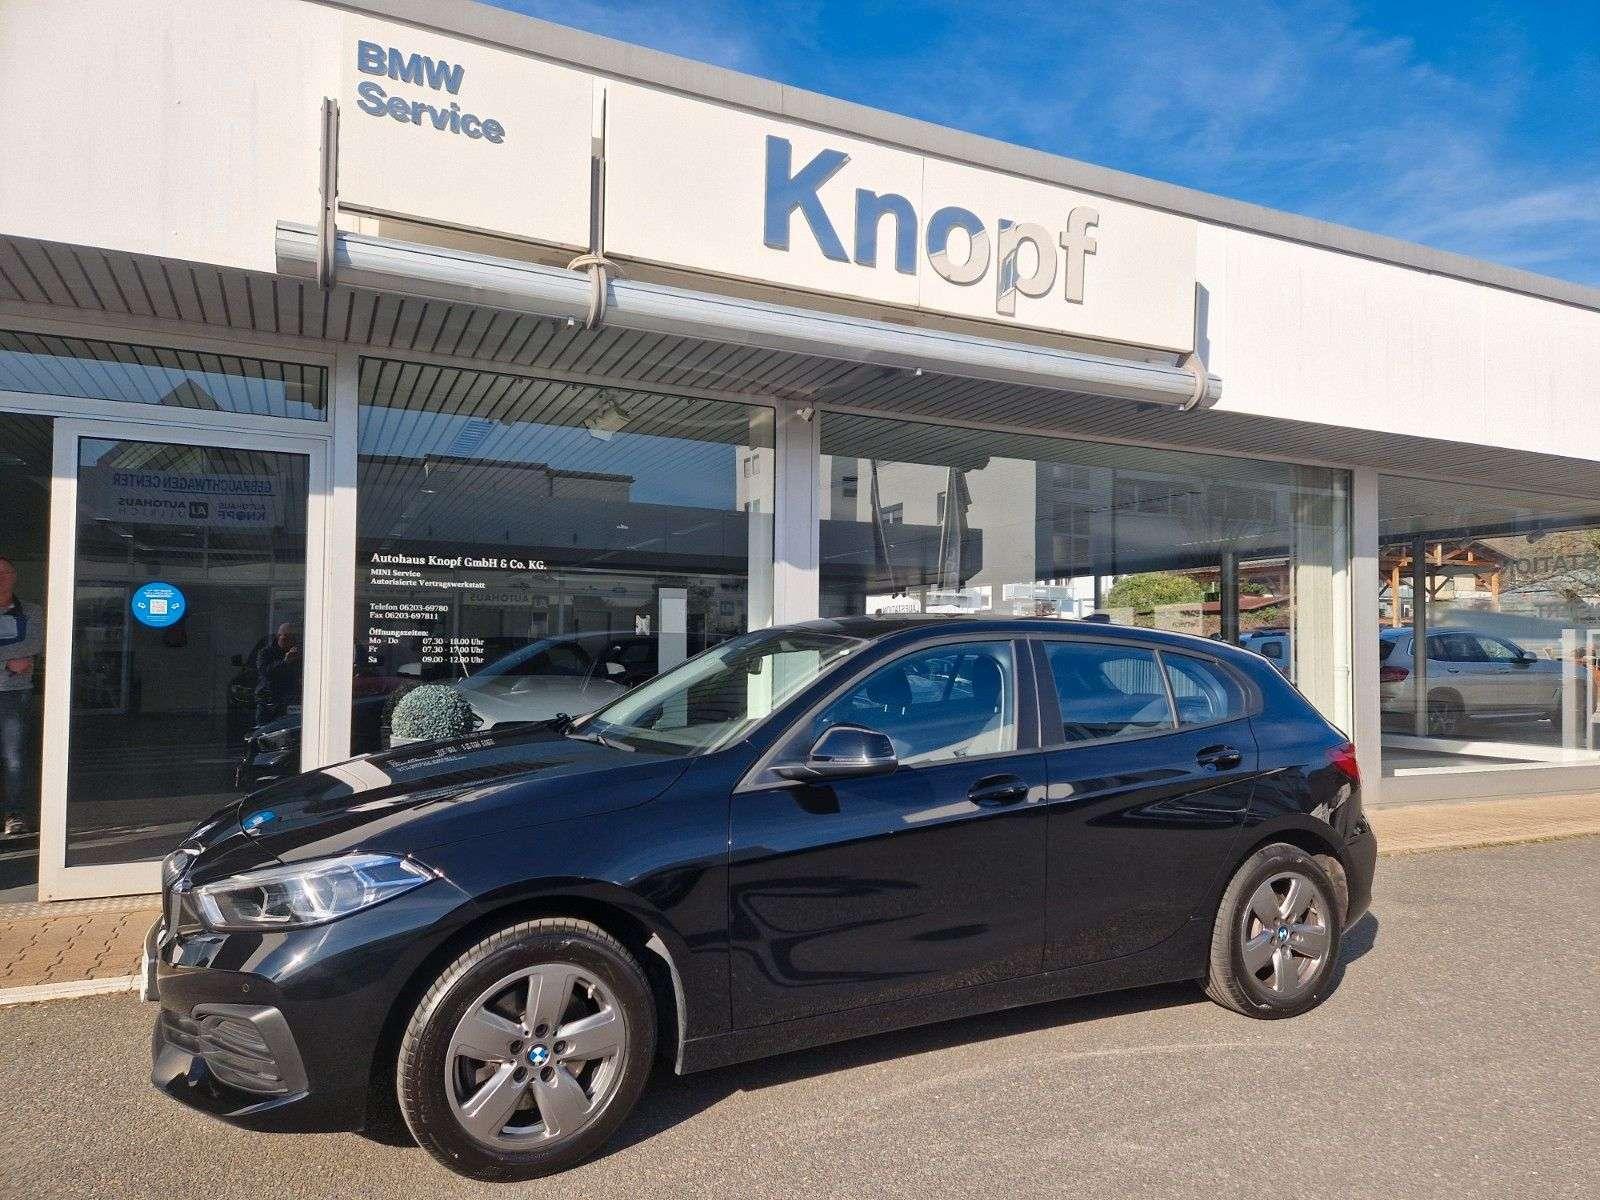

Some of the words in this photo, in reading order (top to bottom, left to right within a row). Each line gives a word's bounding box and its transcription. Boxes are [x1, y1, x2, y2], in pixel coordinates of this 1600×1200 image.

[357, 39, 465, 95] BMW
[357, 80, 506, 144] Service
[764, 134, 1099, 317] Knopf
[370, 552, 426, 565] Autohaus
[427, 555, 462, 569] Knopf
[464, 557, 498, 568] GmbH
[500, 560, 507, 568] &
[509, 560, 526, 569] Co.
[528, 560, 547, 570] KG.
[370, 568, 391, 576] MINI
[392, 569, 421, 578] Service
[370, 578, 417, 587] Autorisierte
[418, 579, 486, 589] Vertragswerkstatt
[369, 602, 398, 611] Telefon
[399, 603, 448, 612] 06203-69780
[369, 611, 384, 619] Fax
[385, 612, 438, 620] 06203-697811
[368, 627, 428, 637] Öffnungszeiten:
[471, 638, 485, 646] Uhr
